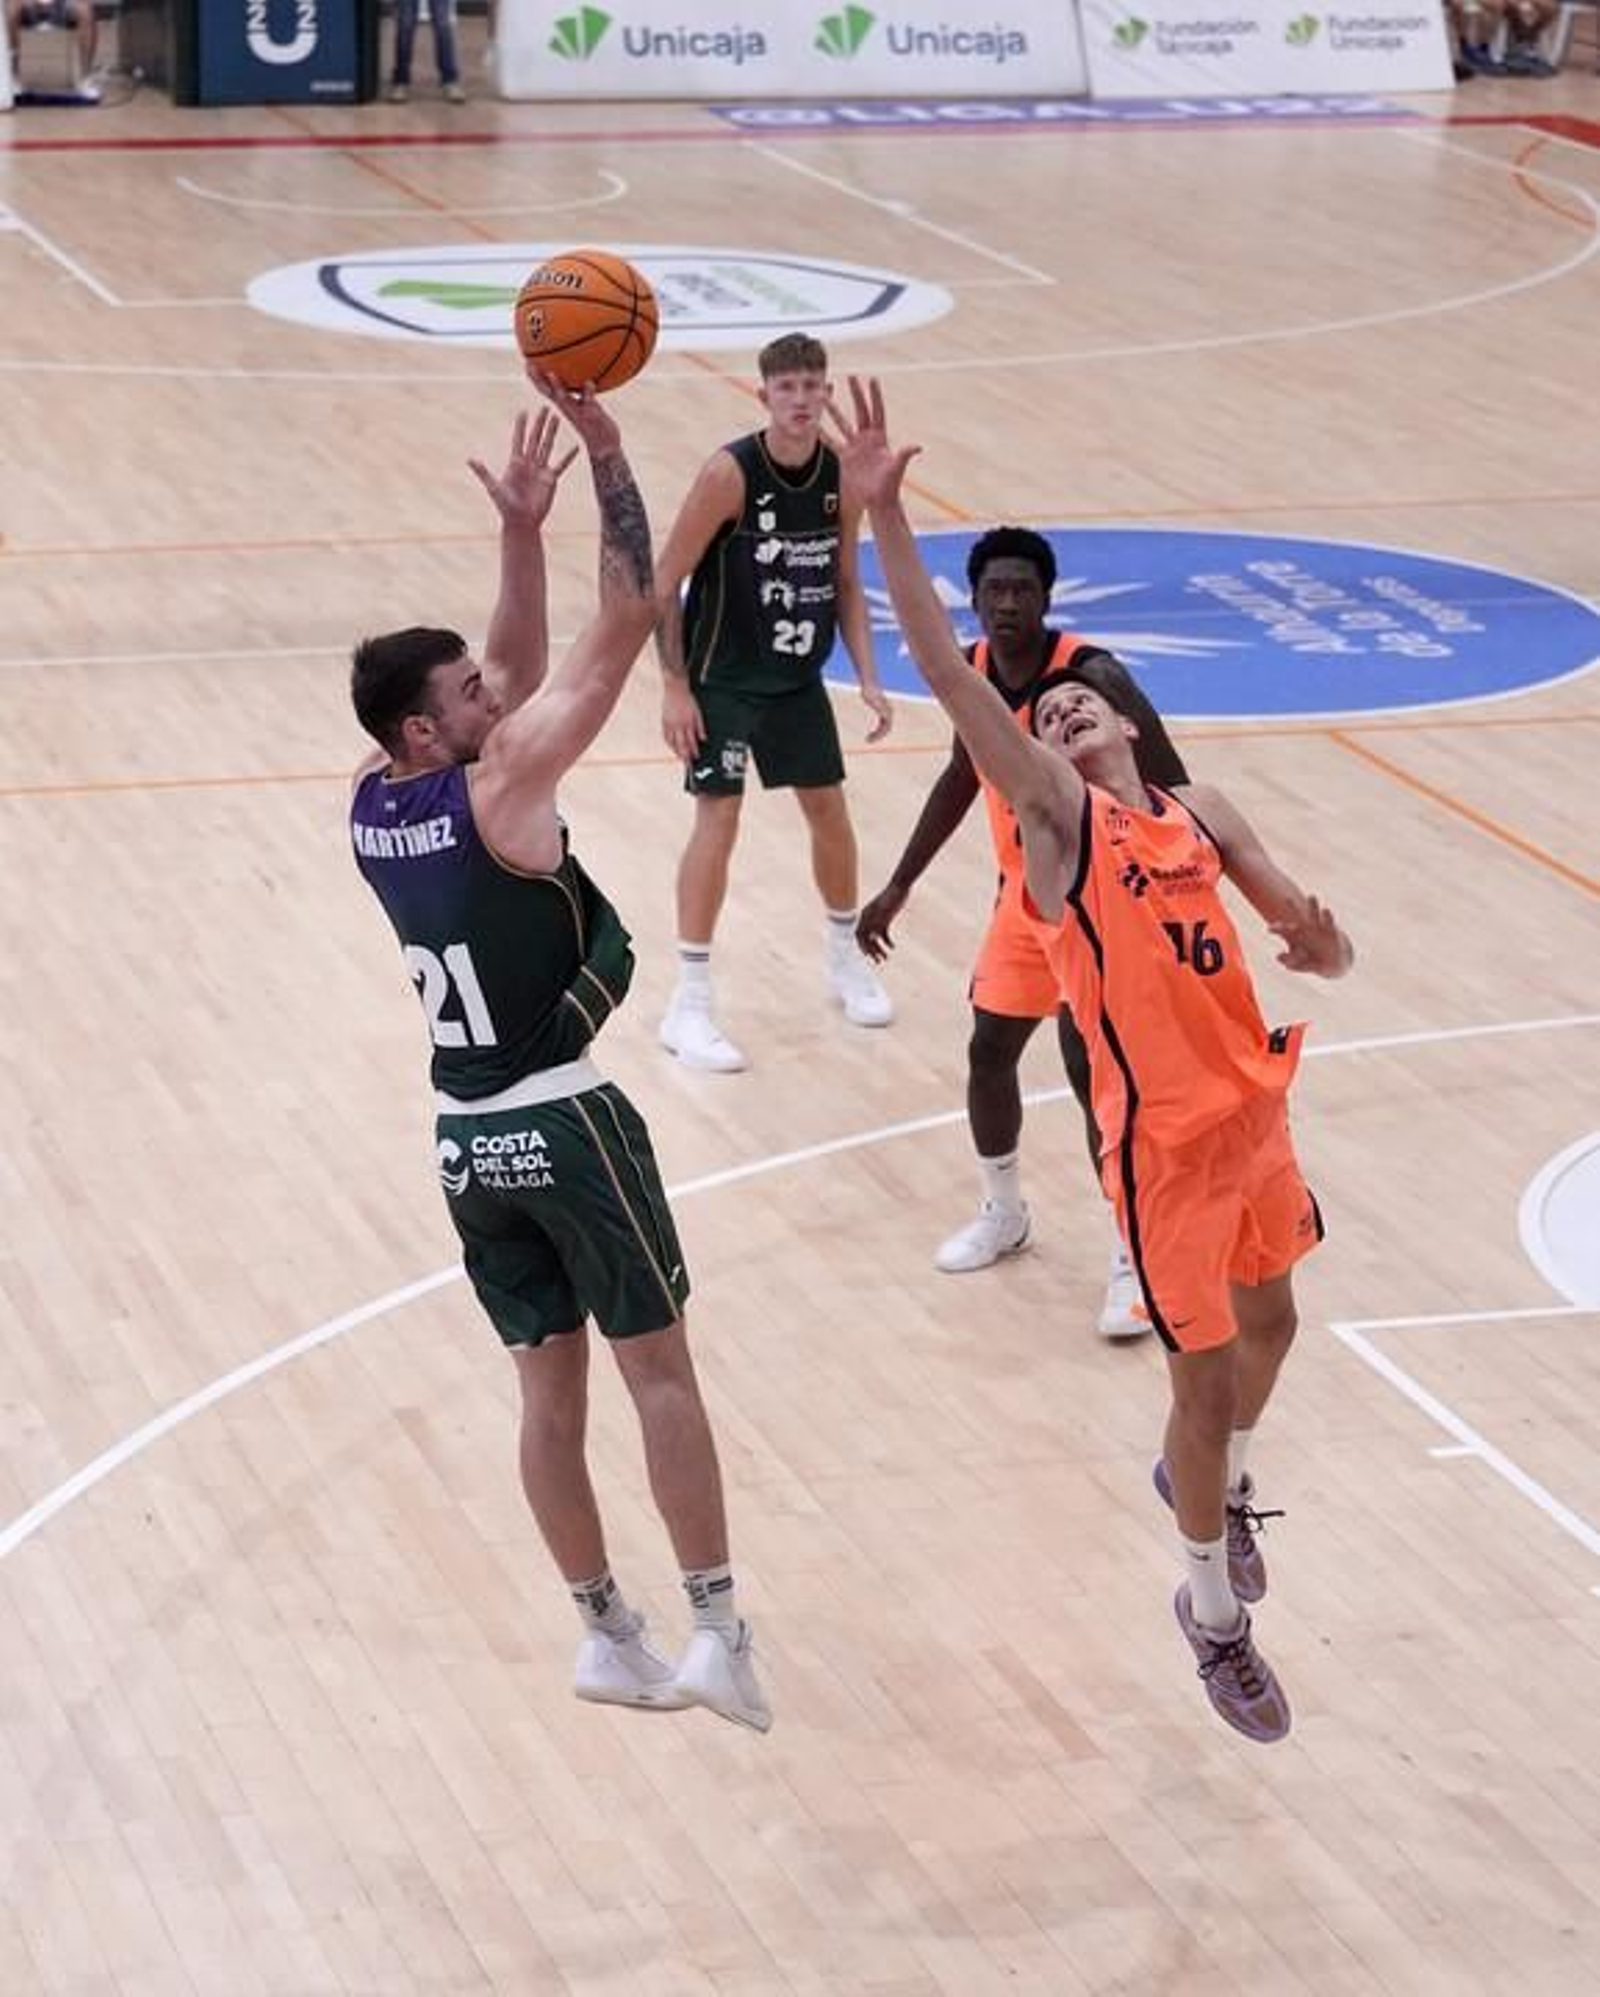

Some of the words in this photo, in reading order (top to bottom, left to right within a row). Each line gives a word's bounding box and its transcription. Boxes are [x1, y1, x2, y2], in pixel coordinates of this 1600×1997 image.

[622, 25, 767, 65] Unicaja
[886, 22, 1027, 63] Unicaja
[1162, 919, 1224, 976] 16
[403, 942, 498, 1048] 21
[471, 1129, 548, 1155] COSTA
[472, 1155, 510, 1174] DEL
[511, 1151, 552, 1171] SOL
